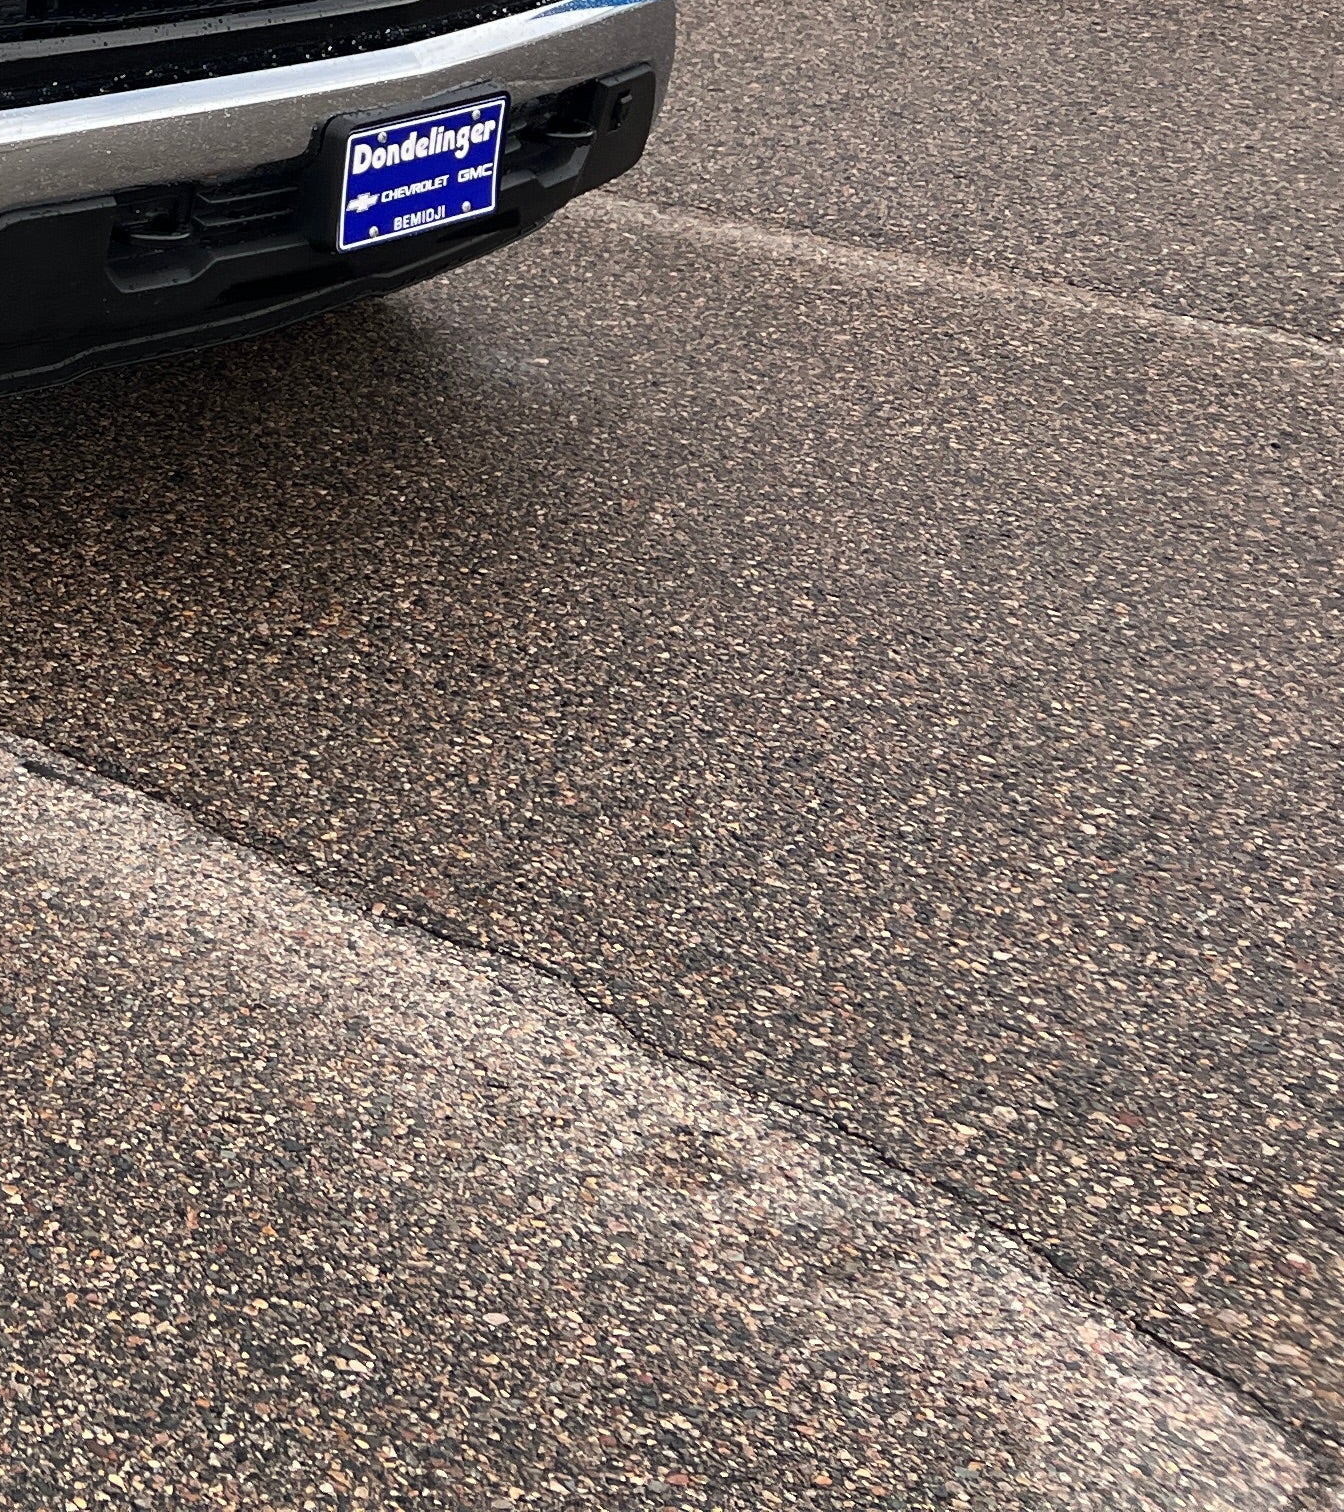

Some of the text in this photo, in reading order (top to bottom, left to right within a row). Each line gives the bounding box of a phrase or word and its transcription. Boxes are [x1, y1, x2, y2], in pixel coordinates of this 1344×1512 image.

[352, 119, 497, 175] Dondelinger
[381, 162, 494, 203] CHEVROLET GMC
[393, 205, 446, 231] BEMIDJI
